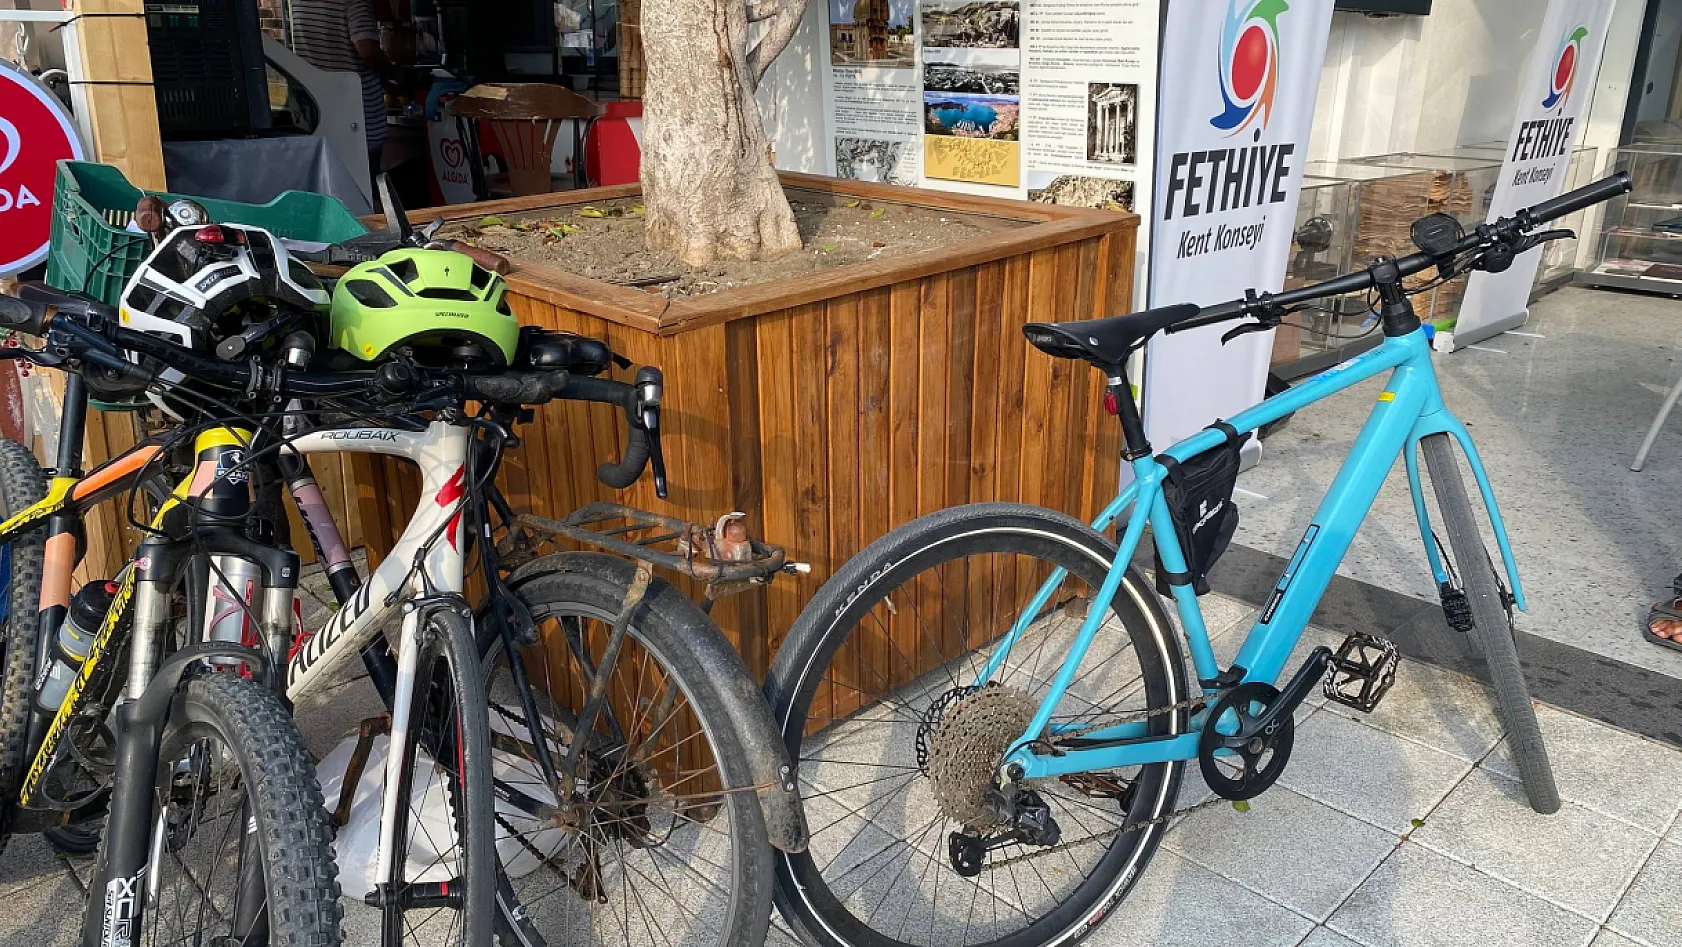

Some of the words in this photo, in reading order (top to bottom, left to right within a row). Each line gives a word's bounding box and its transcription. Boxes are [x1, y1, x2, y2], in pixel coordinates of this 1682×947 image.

[1511, 108, 1575, 162] FETHİYE
[1163, 127, 1295, 221] FETHİYE
[1177, 227, 1213, 259] Kent
[1213, 215, 1266, 251] Konseyi
[320, 429, 400, 443] ROUBAIX
